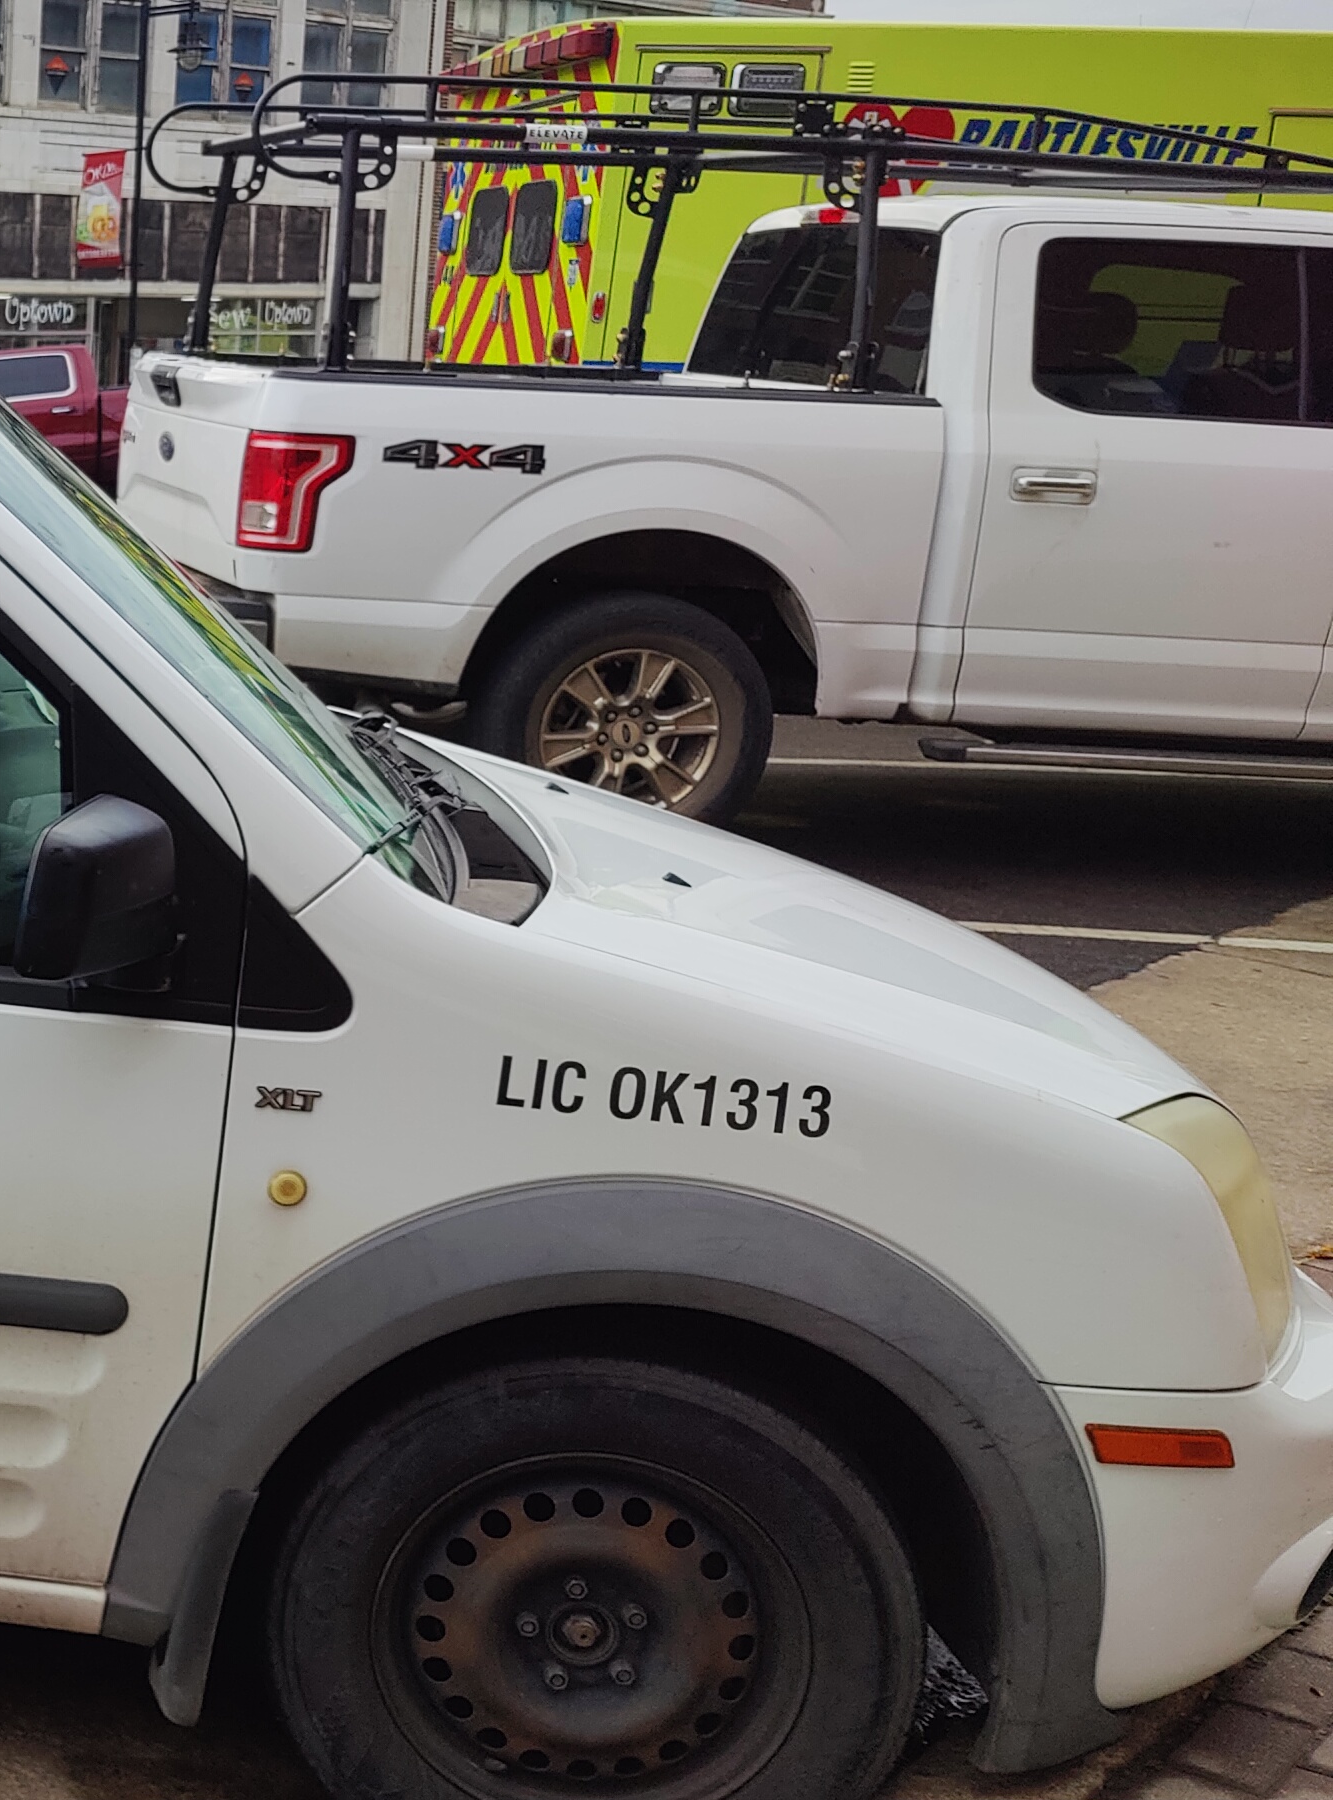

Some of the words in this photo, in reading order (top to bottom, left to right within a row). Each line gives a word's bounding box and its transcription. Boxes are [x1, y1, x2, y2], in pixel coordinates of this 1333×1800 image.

[529, 127, 584, 140] ELEVATE
[5, 297, 75, 331] Uptown
[264, 300, 312, 331] Uptown
[255, 1086, 322, 1112] XLT
[496, 1055, 587, 1114] LIC
[609, 1066, 832, 1138] OK1313
